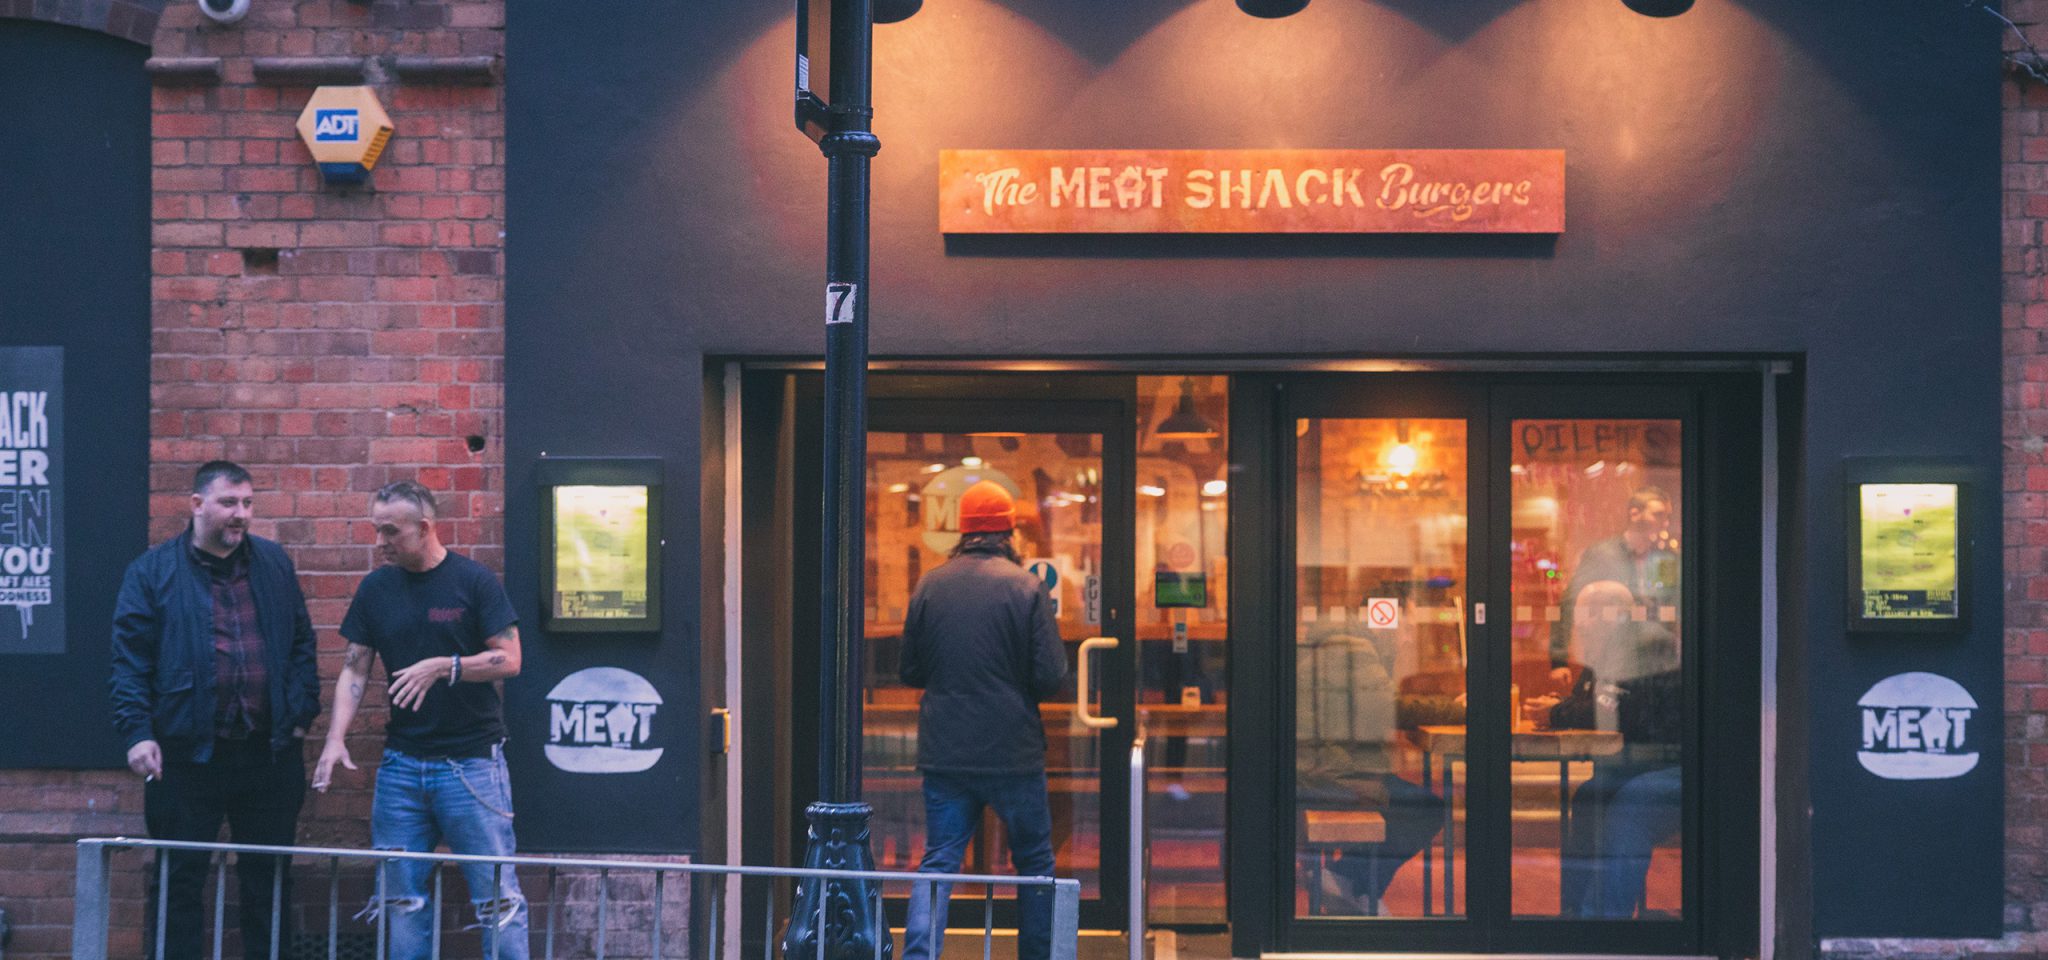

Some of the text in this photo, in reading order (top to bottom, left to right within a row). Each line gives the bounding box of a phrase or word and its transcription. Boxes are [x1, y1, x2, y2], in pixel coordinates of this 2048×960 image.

[316, 115, 358, 136] ADT
[975, 163, 1532, 221] The MEAT SHACK Burgers
[829, 286, 851, 321] 7
[1088, 578, 1098, 622] PULL
[550, 702, 657, 748] MEAT
[1863, 707, 1971, 753] MEAT
